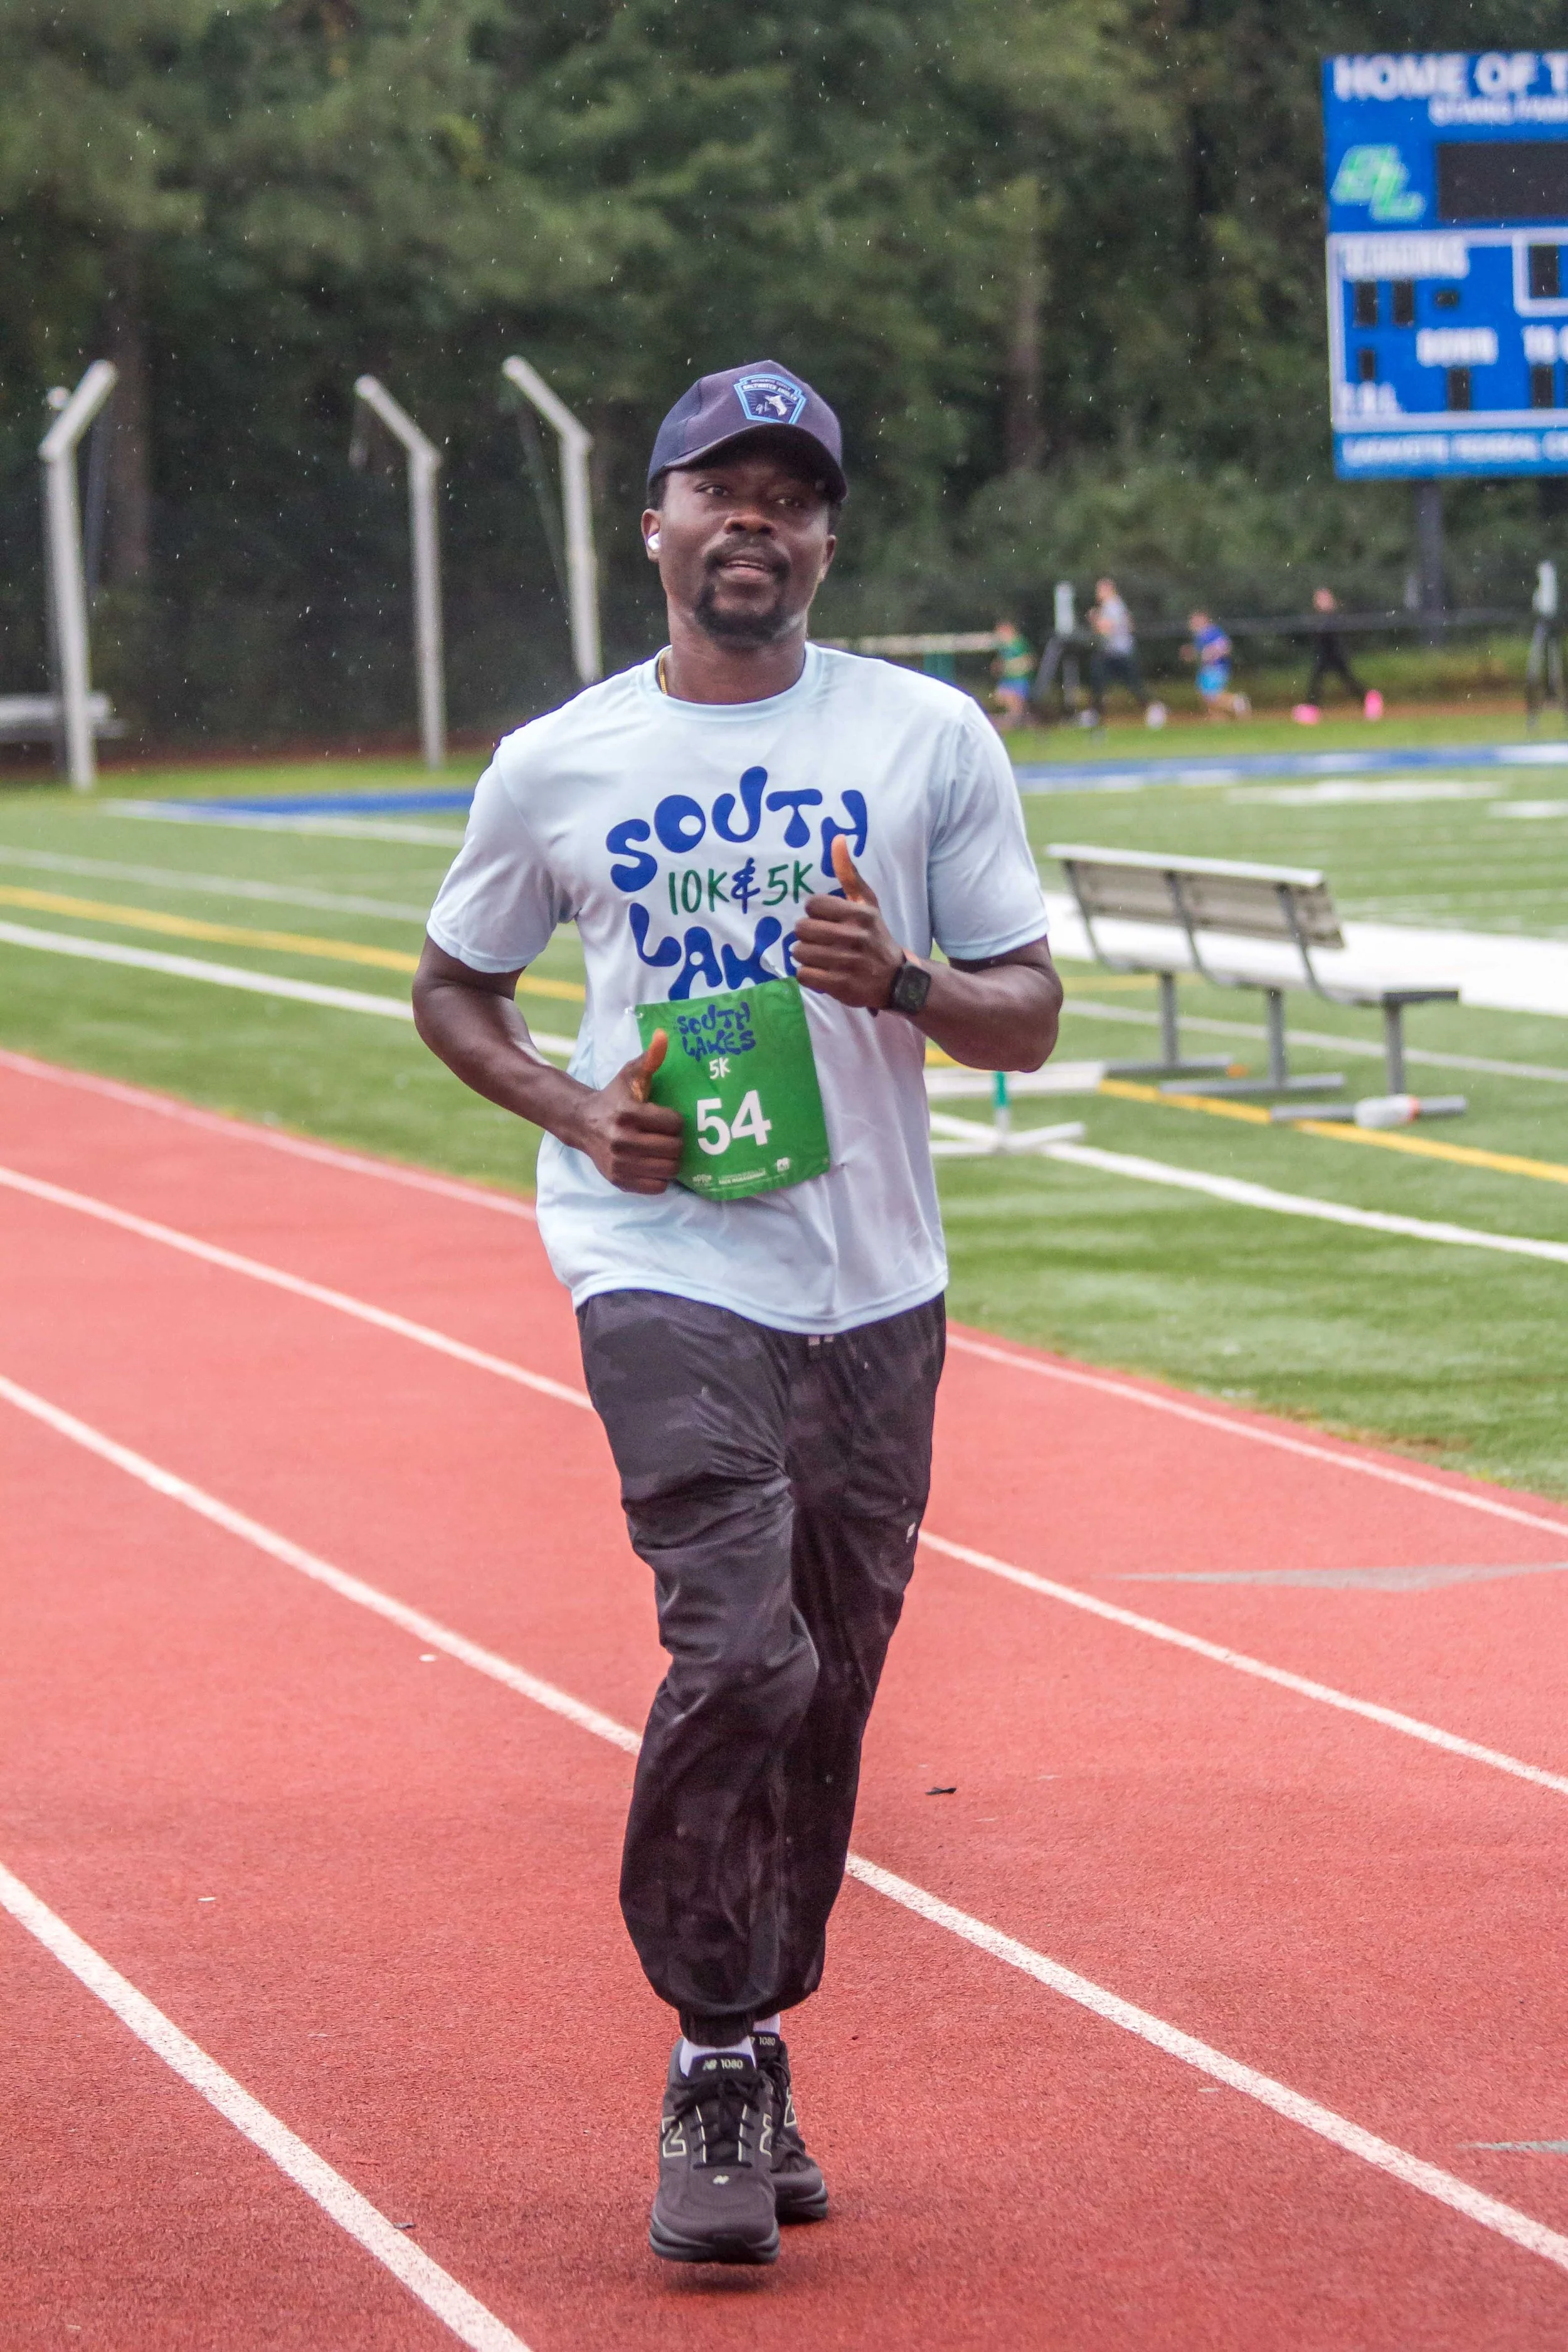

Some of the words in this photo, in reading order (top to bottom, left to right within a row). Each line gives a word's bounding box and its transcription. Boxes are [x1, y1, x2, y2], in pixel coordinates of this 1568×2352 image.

[1334, 54, 1466, 98] HOME
[1475, 51, 1537, 97] OF
[606, 766, 867, 893] SOUTH
[677, 1002, 751, 1034] SOUTH
[682, 1029, 756, 1062] LAKES
[709, 1057, 731, 1079] 5K
[697, 1089, 772, 1155] 54
[759, 2037, 775, 2046] 1080
[721, 2059, 743, 2069] 1080
